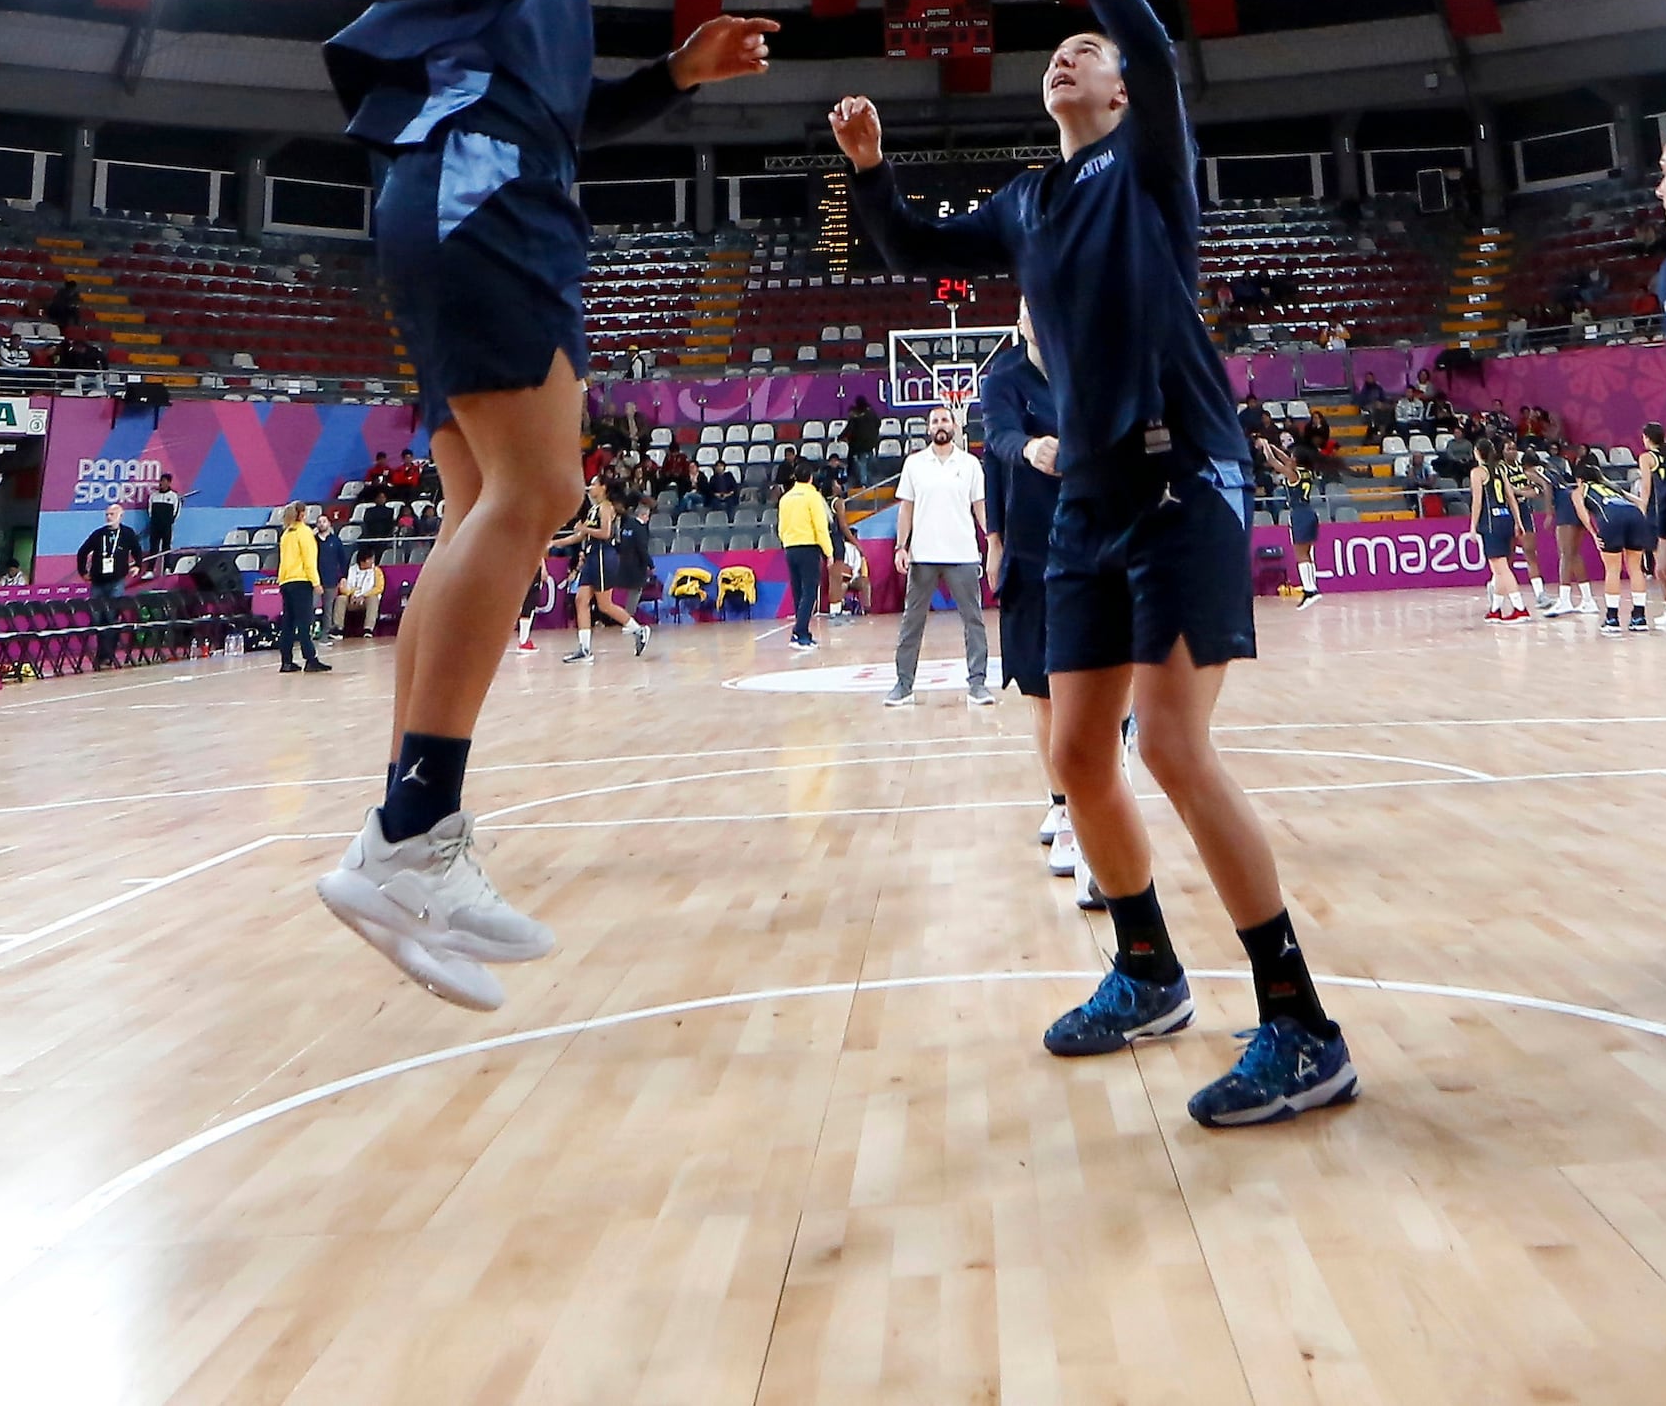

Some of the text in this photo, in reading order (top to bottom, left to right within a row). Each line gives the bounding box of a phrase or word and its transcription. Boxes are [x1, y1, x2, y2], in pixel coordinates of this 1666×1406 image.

[937, 279, 967, 299] 24
[78, 458, 161, 480] PANAM
[1302, 482, 1310, 500] 7
